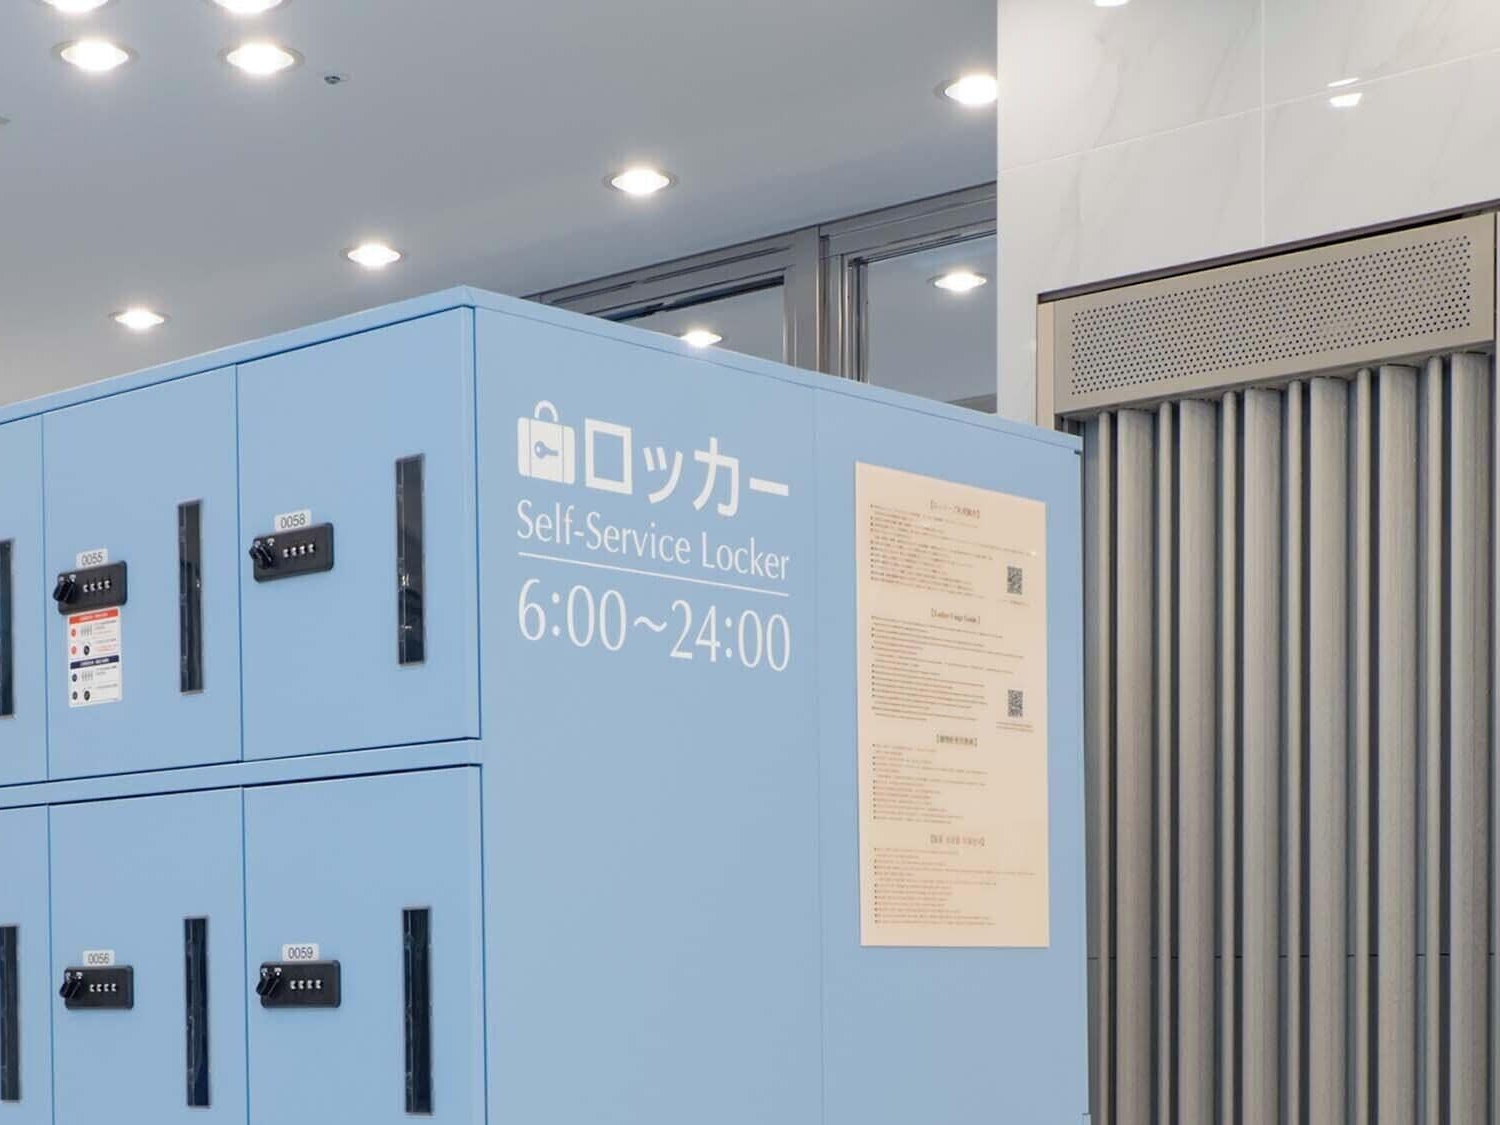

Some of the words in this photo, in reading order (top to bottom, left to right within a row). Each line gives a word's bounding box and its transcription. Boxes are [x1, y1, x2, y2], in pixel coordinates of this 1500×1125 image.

[584, 417, 790, 521] ロッカー
[280, 513, 306, 529] 0058
[516, 499, 692, 566] Self-Service
[700, 530, 790, 582] Locker
[288, 946, 314, 959] 0059
